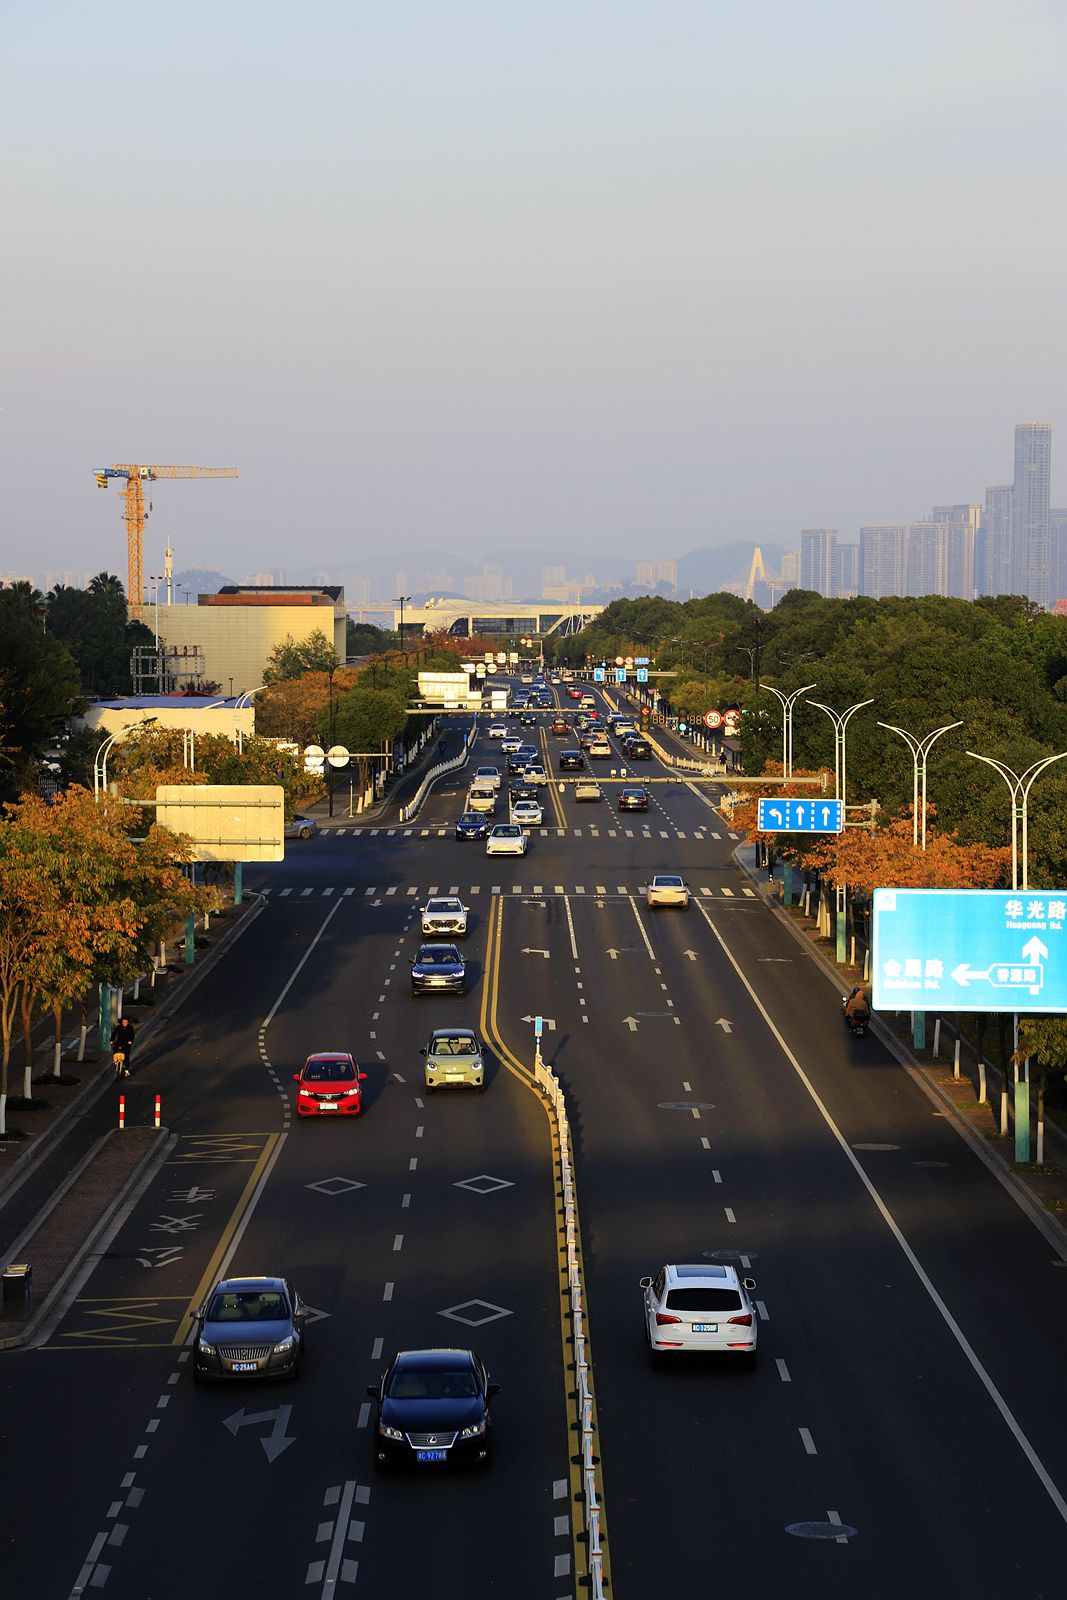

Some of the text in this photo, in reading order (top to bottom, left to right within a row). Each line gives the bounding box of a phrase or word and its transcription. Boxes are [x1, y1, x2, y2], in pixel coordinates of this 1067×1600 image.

[708, 715, 719, 724] 50
[1004, 899, 1067, 920] 华光路
[1006, 920, 1064, 931] Huaguang Rd.
